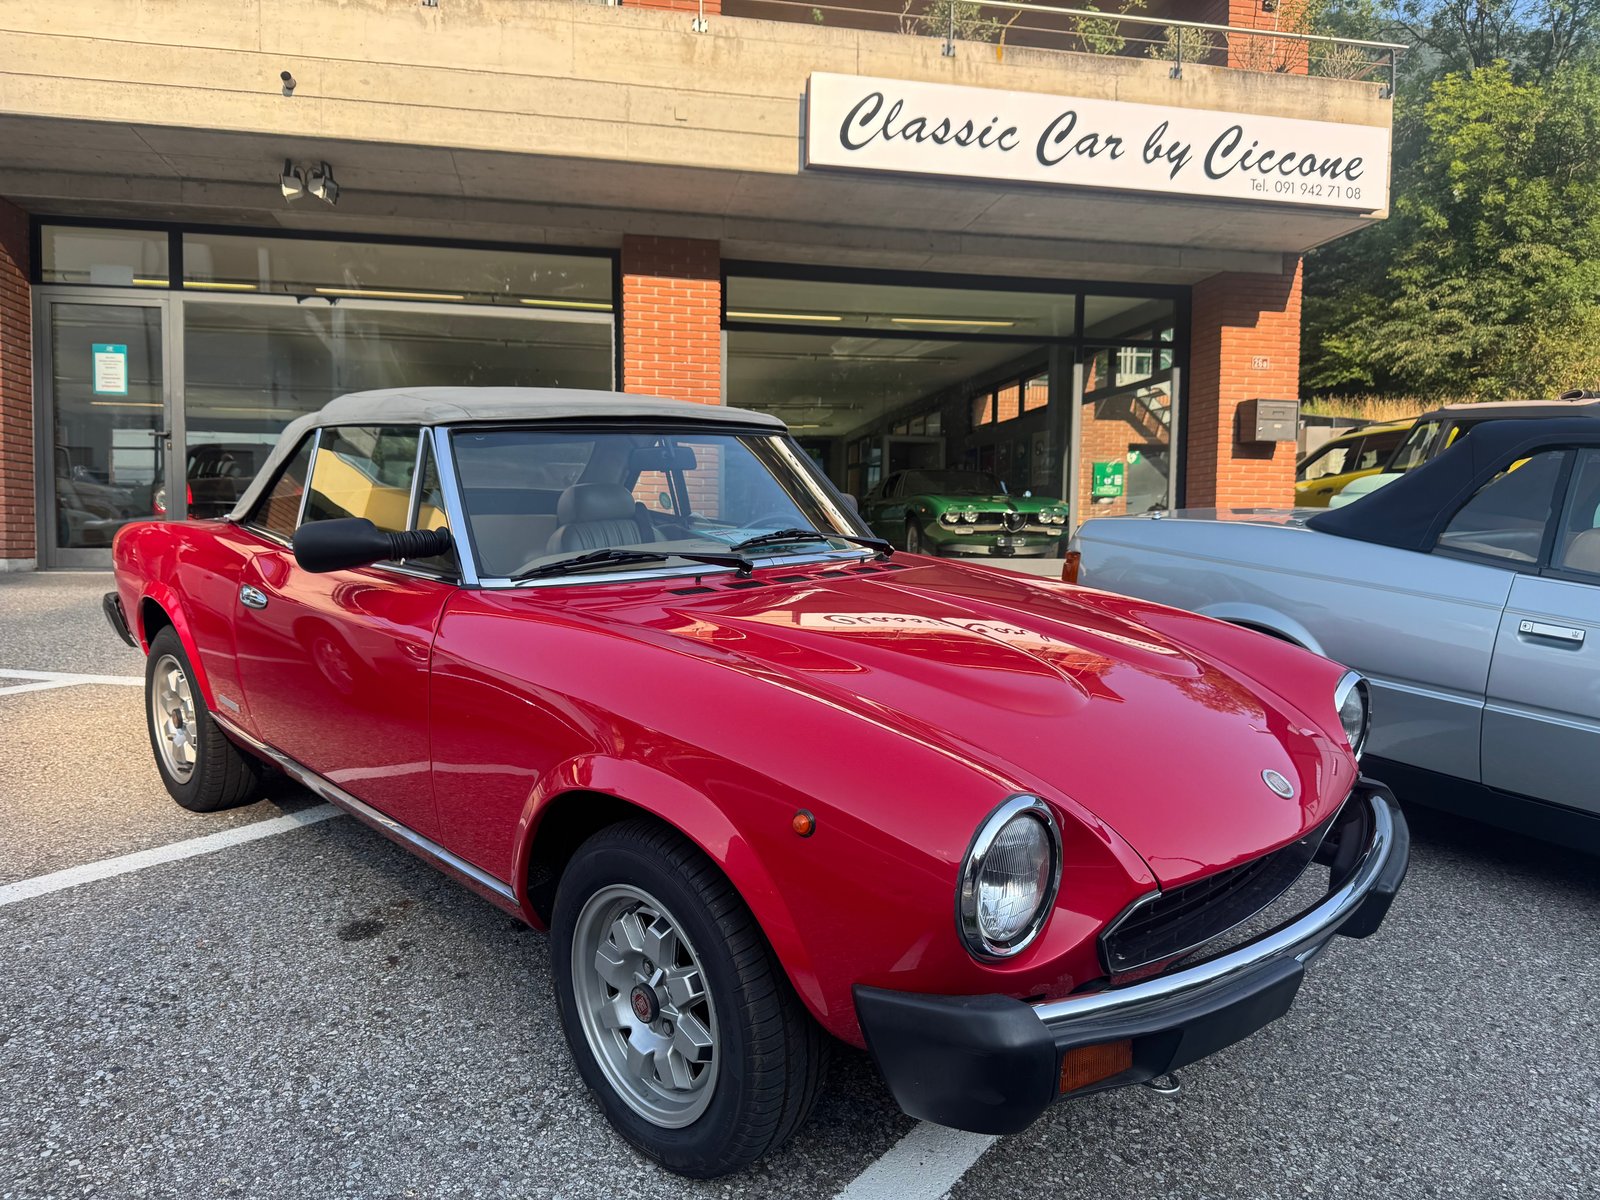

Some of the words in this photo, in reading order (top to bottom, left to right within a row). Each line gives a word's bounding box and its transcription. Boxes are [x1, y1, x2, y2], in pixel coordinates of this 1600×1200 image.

[840, 92, 1019, 151] Classic
[1036, 111, 1124, 166] Car
[1143, 121, 1192, 179] by
[1204, 125, 1363, 181] Ciccone
[1250, 178, 1269, 193] Tel.
[1274, 180, 1295, 195] 091
[1300, 182, 1323, 197] 942
[1327, 185, 1341, 199] 71
[1345, 186, 1361, 200] 08
